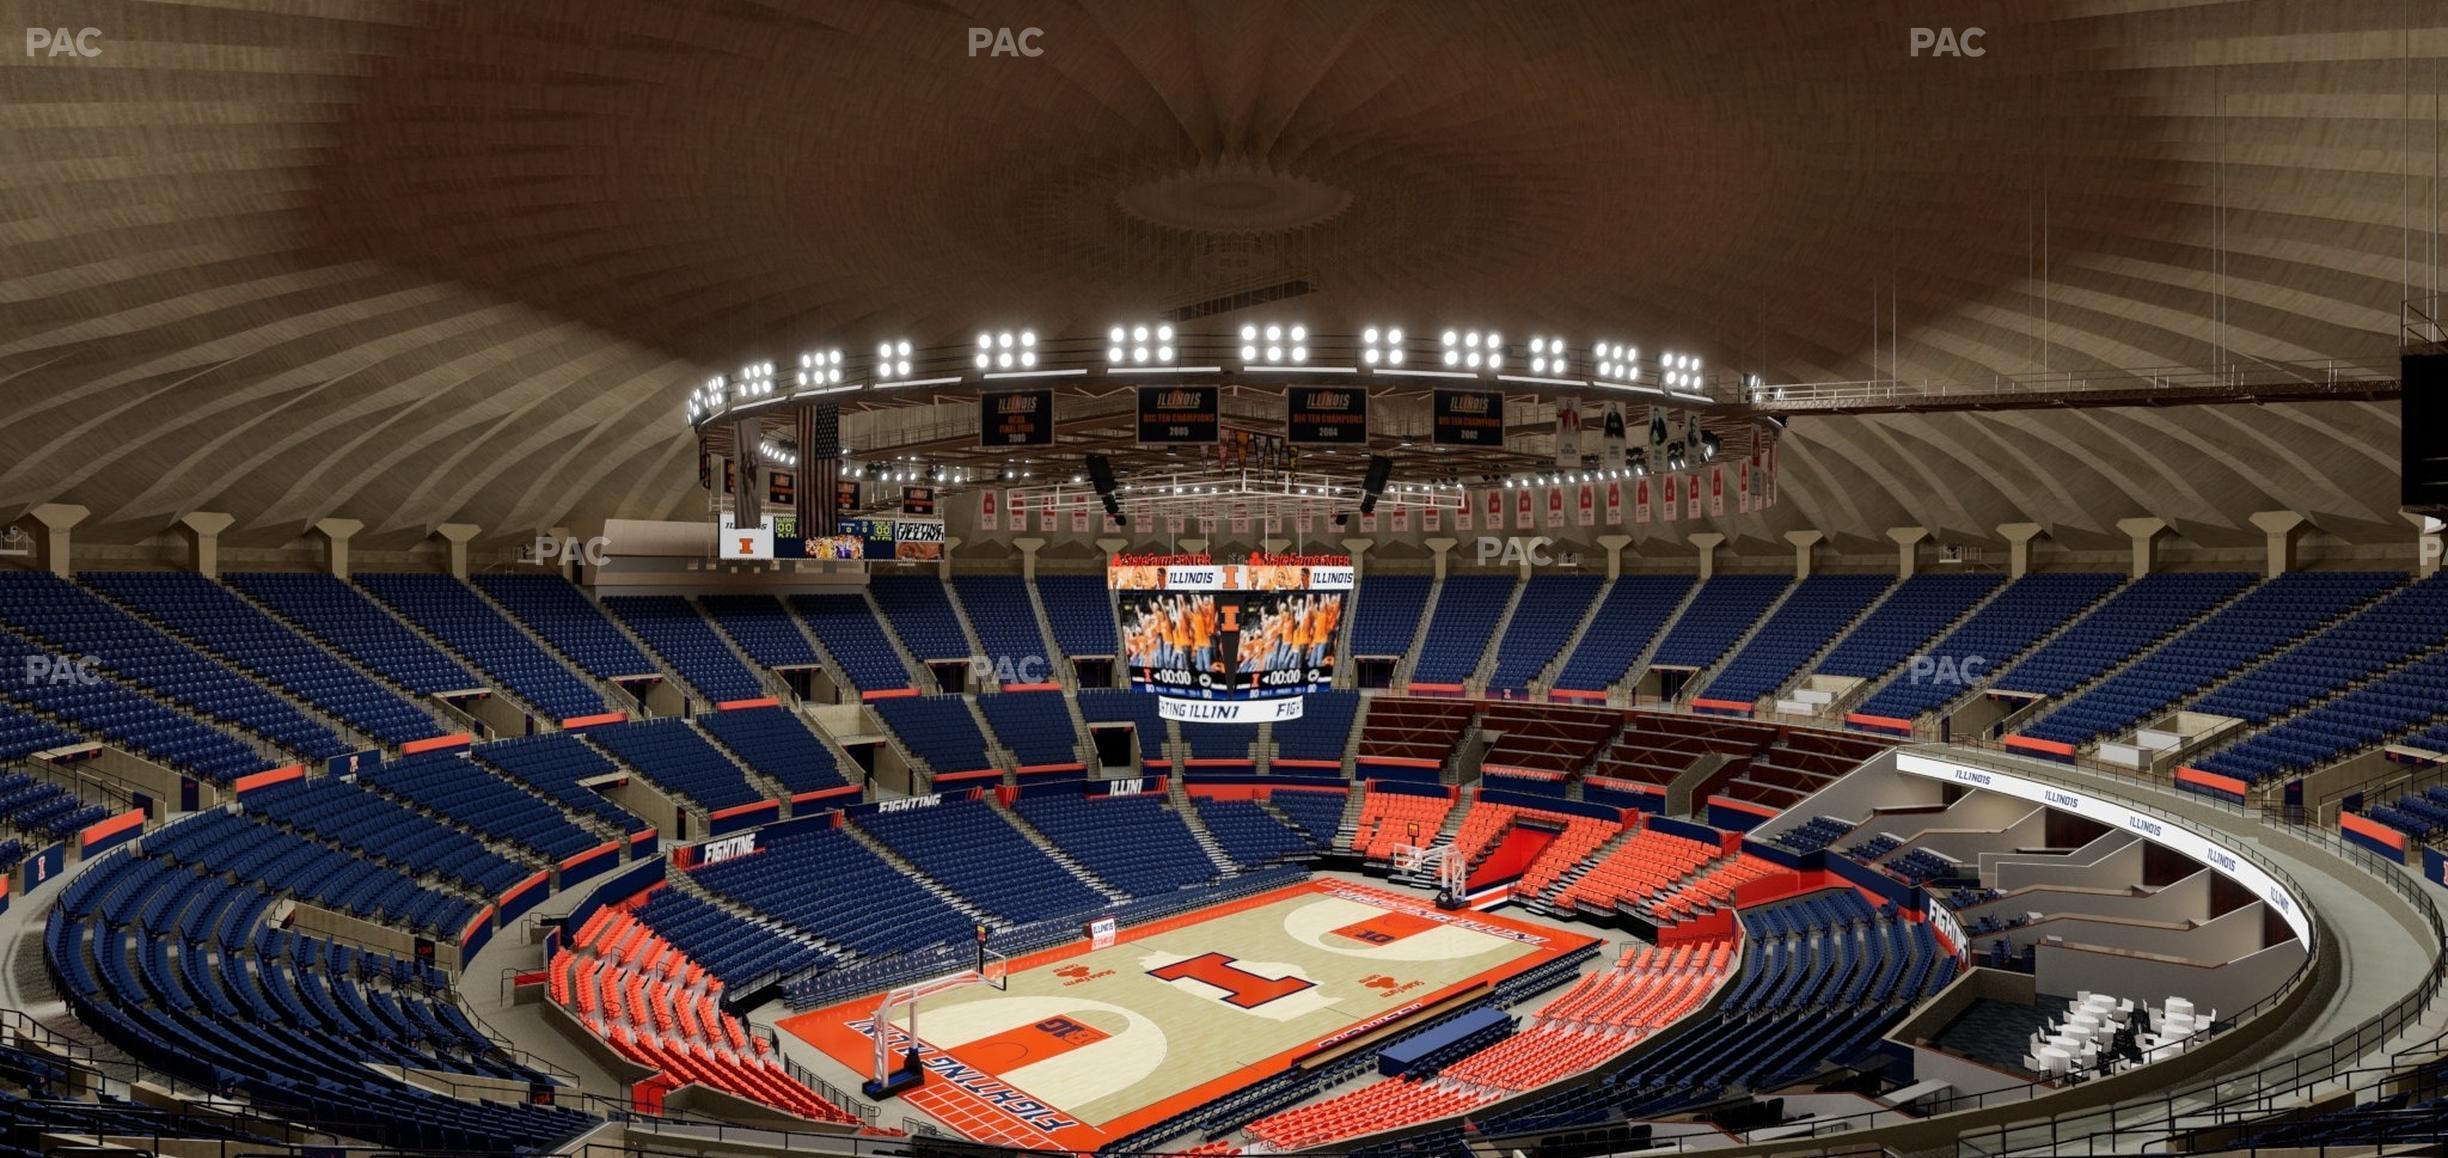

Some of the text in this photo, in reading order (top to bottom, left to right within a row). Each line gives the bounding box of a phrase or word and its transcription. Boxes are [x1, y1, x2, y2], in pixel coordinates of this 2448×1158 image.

[1157, 391, 1201, 407] ILLINOIS
[1306, 393, 1350, 408] ILLINOIS
[1449, 396, 1489, 412] ILLINOIS
[1169, 572, 1214, 584] ILLINOIS
[1312, 572, 1354, 584] ILLINOIS
[1161, 668, 1192, 685] 00:00
[1270, 668, 1301, 686] 00:00
[1189, 704, 1240, 719] ILLINI
[1955, 769, 1992, 786] ILLINOIS
[878, 778, 1143, 814] FIGHTING ILLINI
[2044, 790, 2079, 809] ILLINOIS
[2129, 815, 2162, 837] ILLINOIS
[704, 832, 756, 866] FIGHTING
[2206, 847, 2237, 872] ILLINOIS
[921, 1054, 1081, 1133] FIGHTING
